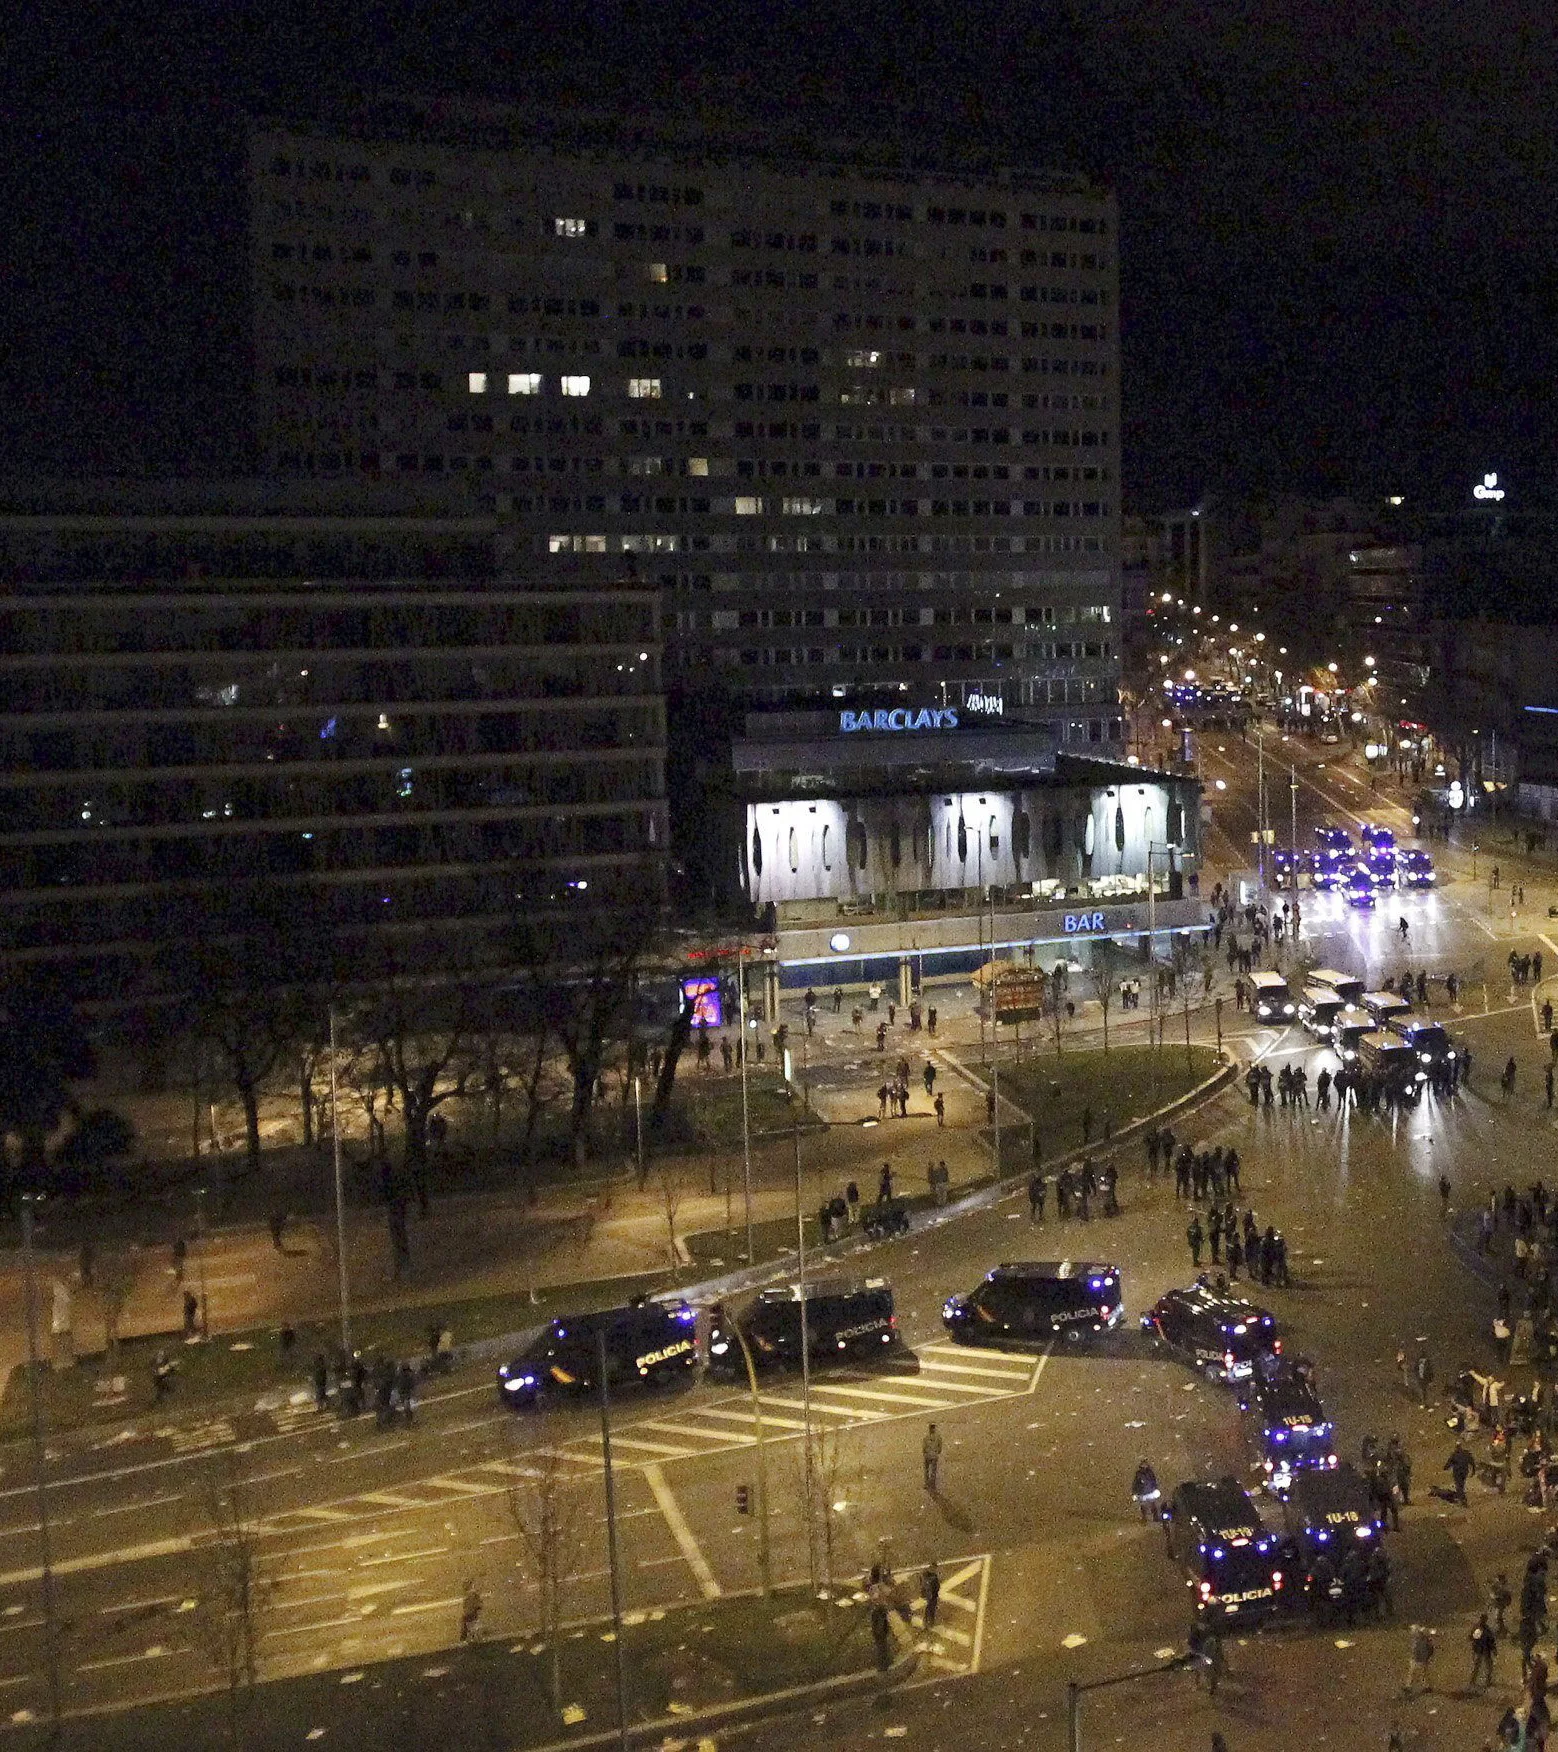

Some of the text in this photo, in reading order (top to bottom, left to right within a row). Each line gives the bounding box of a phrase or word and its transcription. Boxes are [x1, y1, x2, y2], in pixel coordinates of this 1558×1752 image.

[840, 708, 959, 731] BARCLAYS
[1064, 912, 1105, 932] BAR
[1050, 1307, 1098, 1323] POLICIA
[835, 1319, 887, 1341] POLICIA
[635, 1339, 692, 1368] POLICIA
[1215, 1588, 1273, 1604] OLICIA
